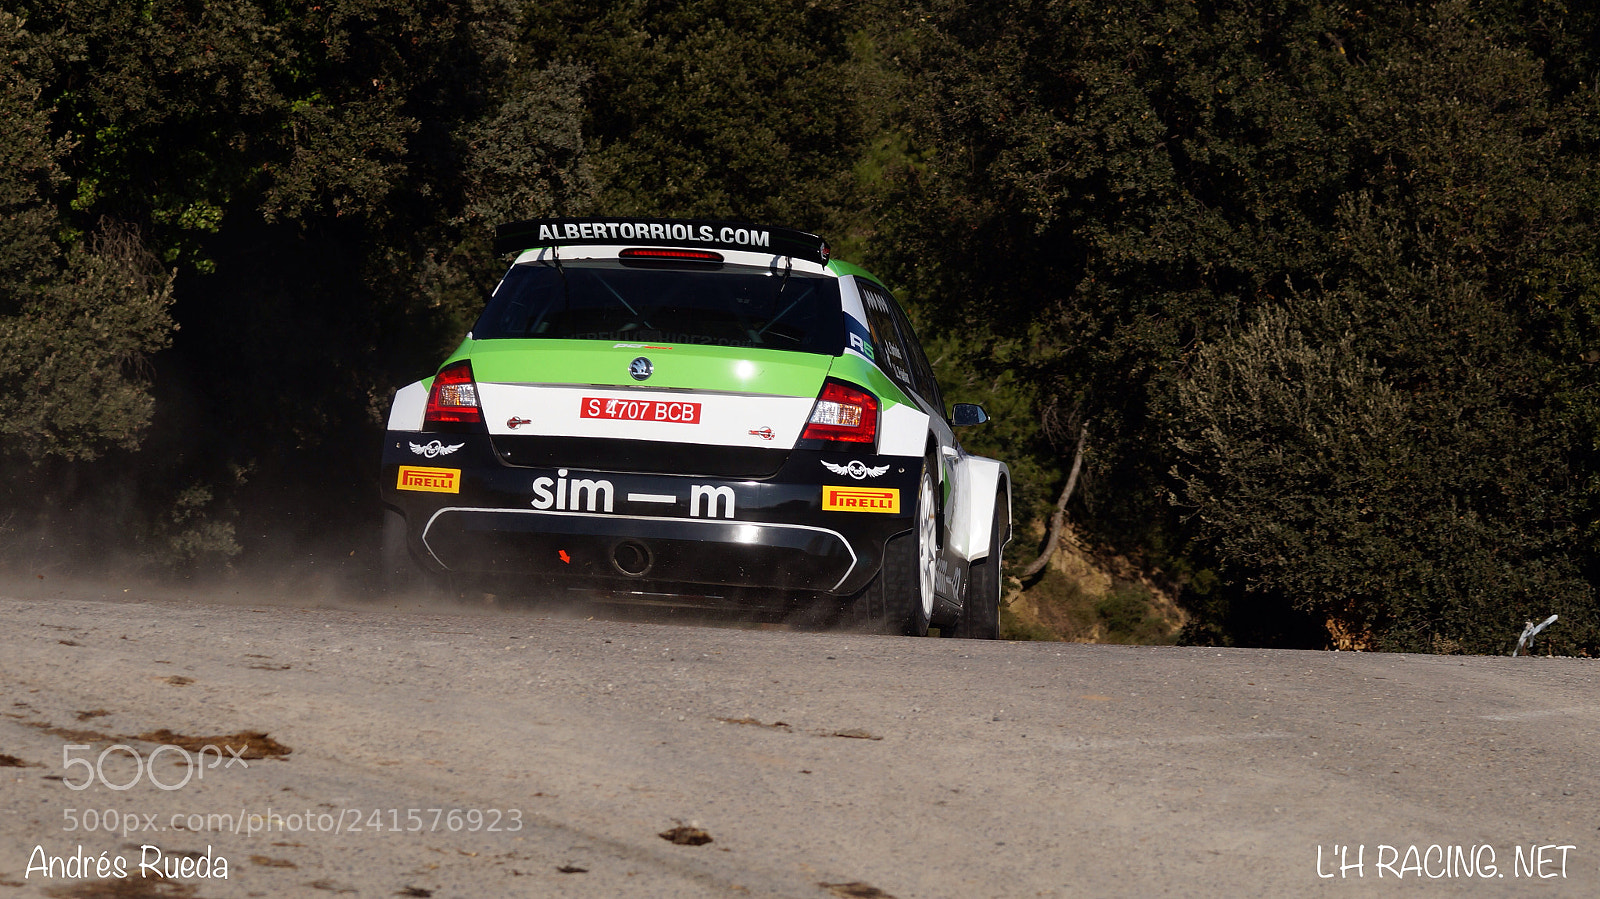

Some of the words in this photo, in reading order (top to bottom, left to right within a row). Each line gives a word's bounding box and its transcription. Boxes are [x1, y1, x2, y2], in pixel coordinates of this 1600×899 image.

[538, 223, 770, 247] ALBERTORRIOLS.COM
[849, 332, 875, 360] R5
[588, 399, 601, 417] S
[605, 399, 650, 420] 4707
[654, 402, 695, 421] BCB
[402, 469, 455, 489] PIRELLI
[530, 468, 614, 513] sim
[689, 484, 735, 519] m
[829, 490, 893, 509] PIRELLI
